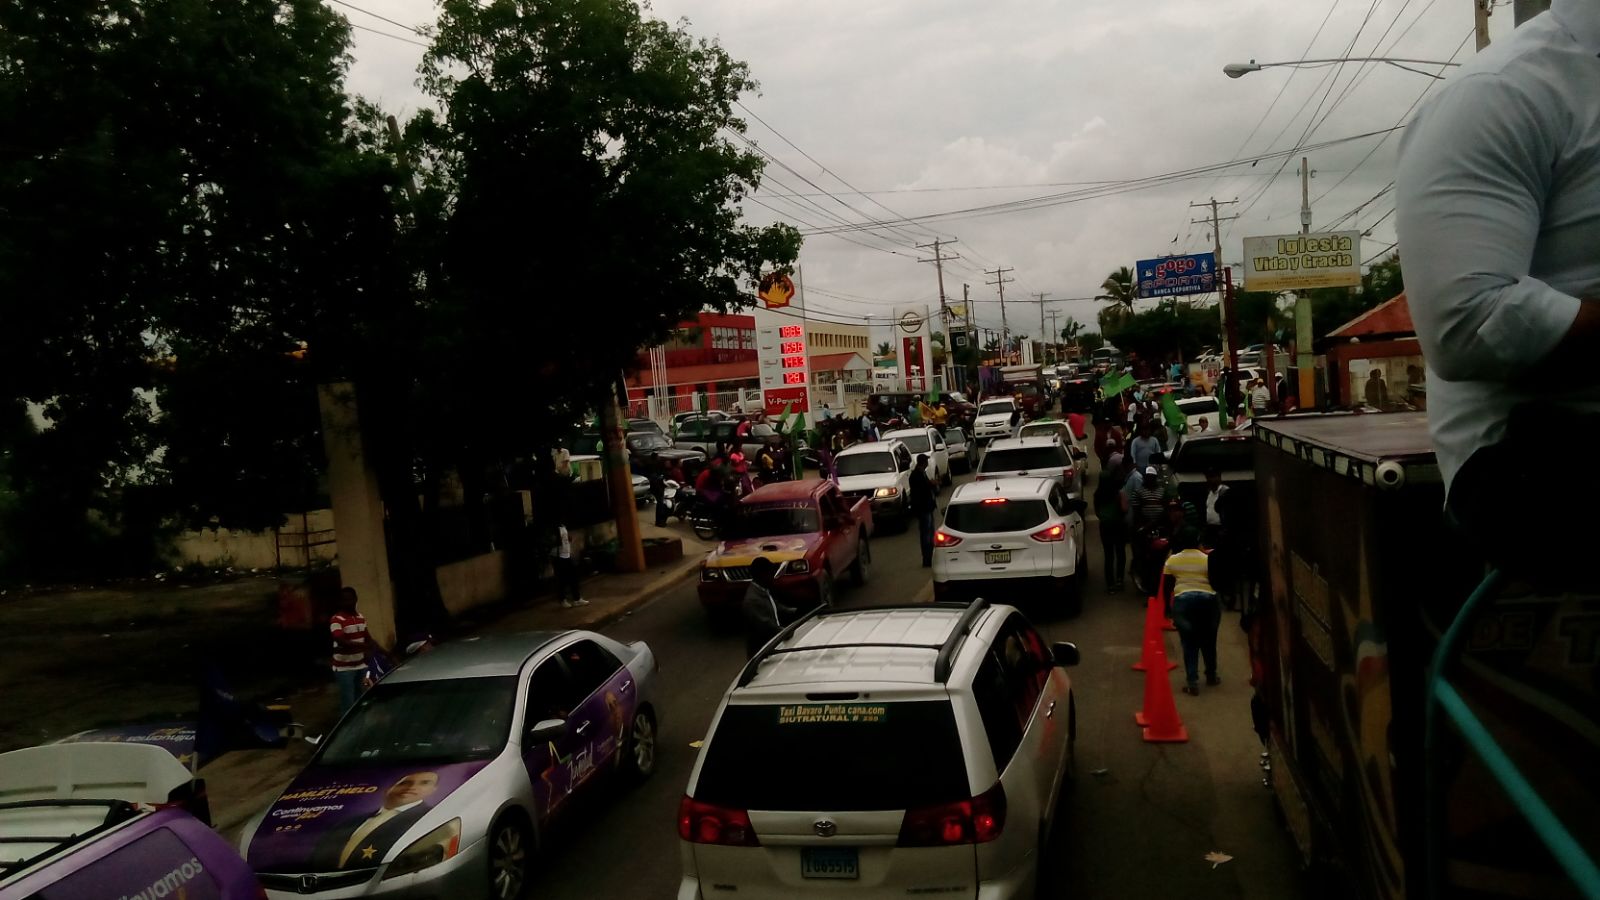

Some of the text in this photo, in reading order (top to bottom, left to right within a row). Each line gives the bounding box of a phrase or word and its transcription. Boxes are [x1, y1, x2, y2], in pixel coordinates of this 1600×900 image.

[1278, 234, 1352, 256] Iglesia
[1155, 257, 1197, 279] gogo
[1253, 252, 1353, 272] Vida y Gracia
[1141, 273, 1214, 290] SPORTS
[1153, 284, 1201, 296] BANCA DEPORTIVA
[780, 704, 886, 716] Taxi Bavaro Punta cana.com
[278, 788, 337, 801] HAMLET
[336, 785, 379, 796] MELO
